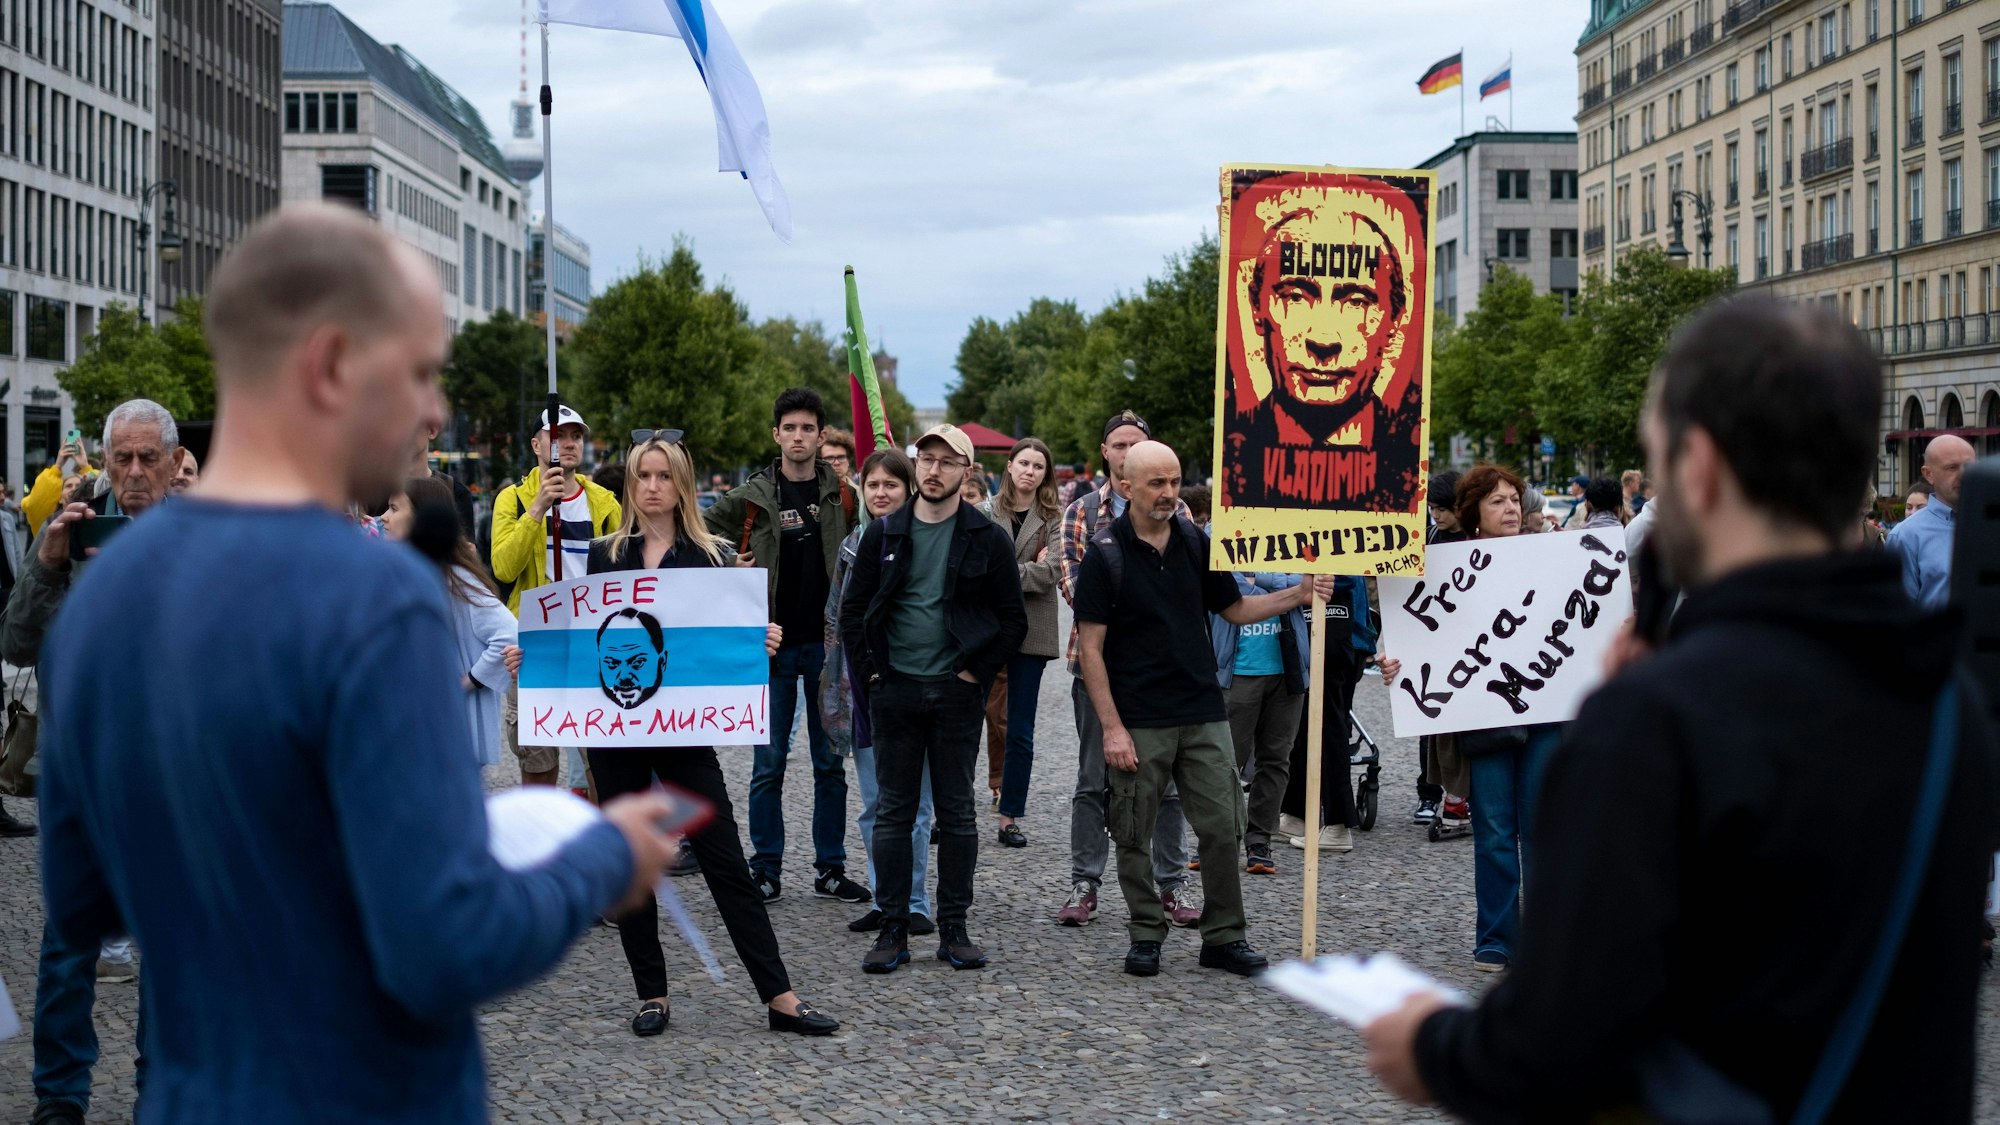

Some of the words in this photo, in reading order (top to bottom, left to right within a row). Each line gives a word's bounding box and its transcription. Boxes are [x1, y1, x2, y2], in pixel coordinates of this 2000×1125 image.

[1280, 242, 1380, 279] BLOODY
[1264, 447, 1377, 504] VLADIMIR
[1221, 524, 1409, 565] WANTED
[1375, 553, 1421, 575] BACHO
[538, 576, 659, 624] FREE
[1403, 548, 1492, 632] Free
[1486, 534, 1627, 714] Murza!
[1401, 589, 1536, 718] Kara-
[533, 684, 766, 739] KARA-MURSA!
